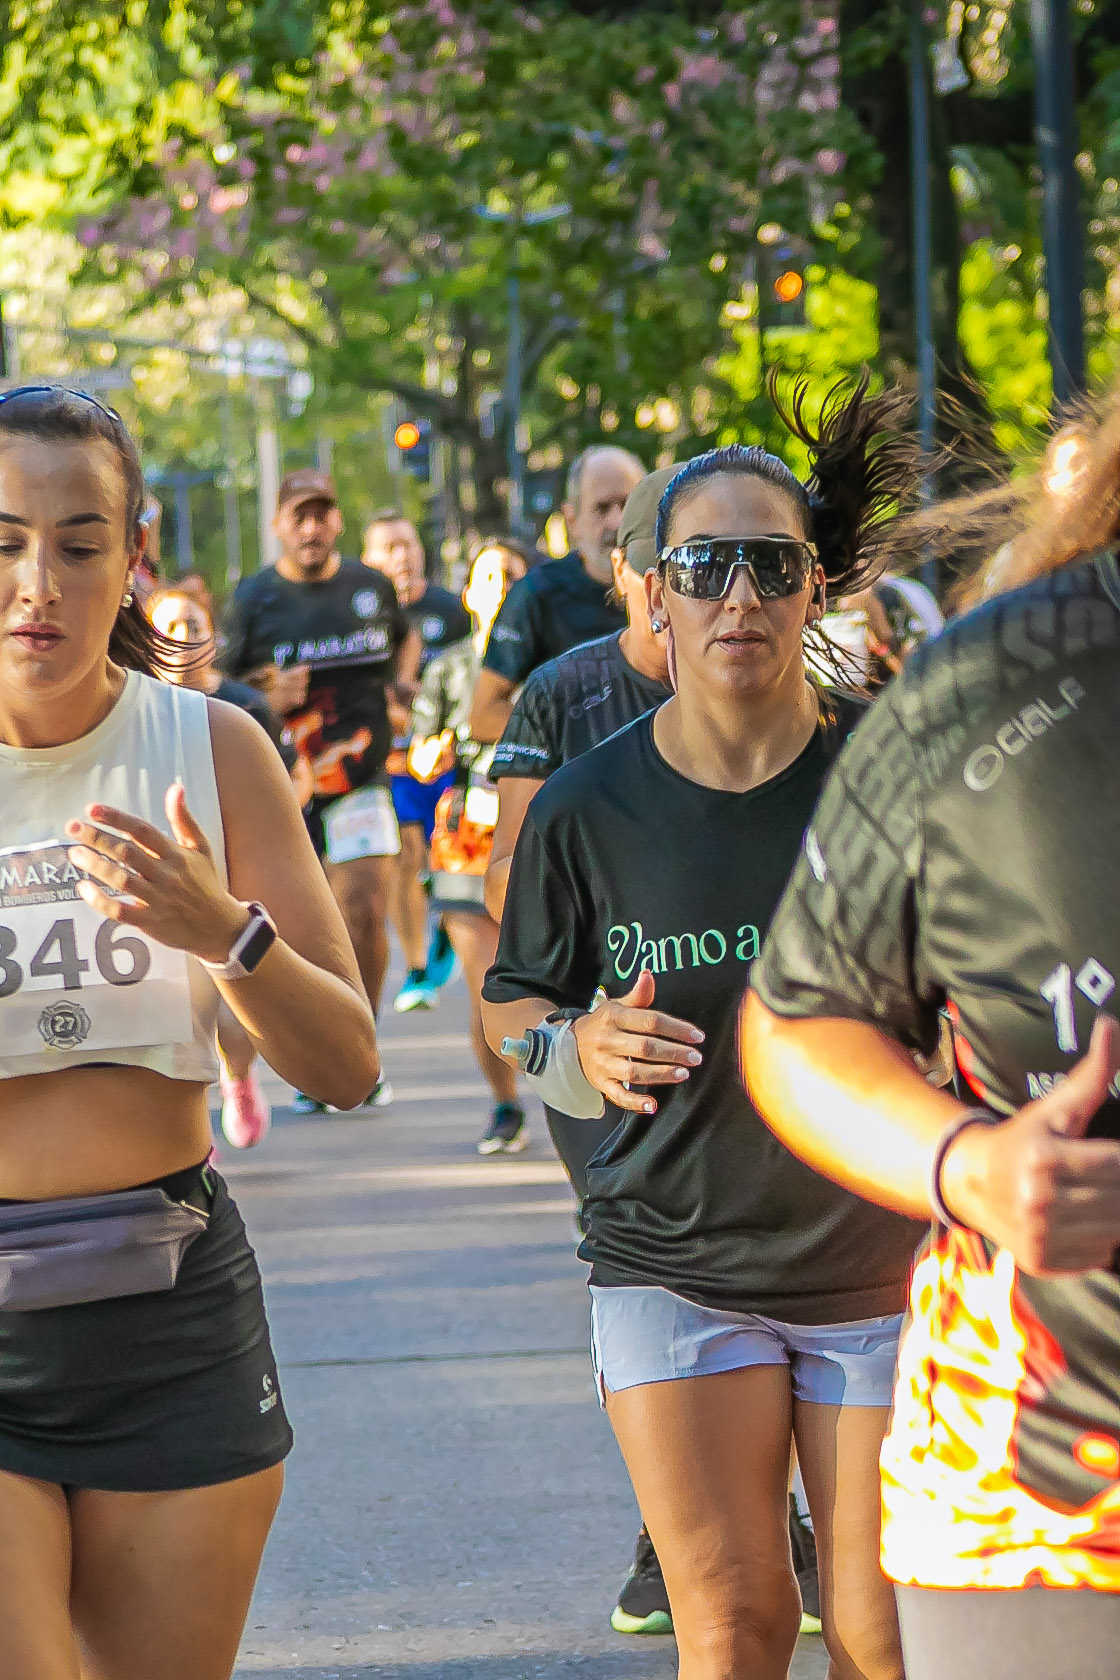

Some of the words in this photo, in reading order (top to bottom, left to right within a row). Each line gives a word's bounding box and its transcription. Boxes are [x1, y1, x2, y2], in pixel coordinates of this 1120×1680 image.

[3, 891, 56, 907] BOMBEROS
[607, 921, 727, 980] Vamo
[735, 924, 761, 961] a
[54, 1015, 75, 1033] 27
